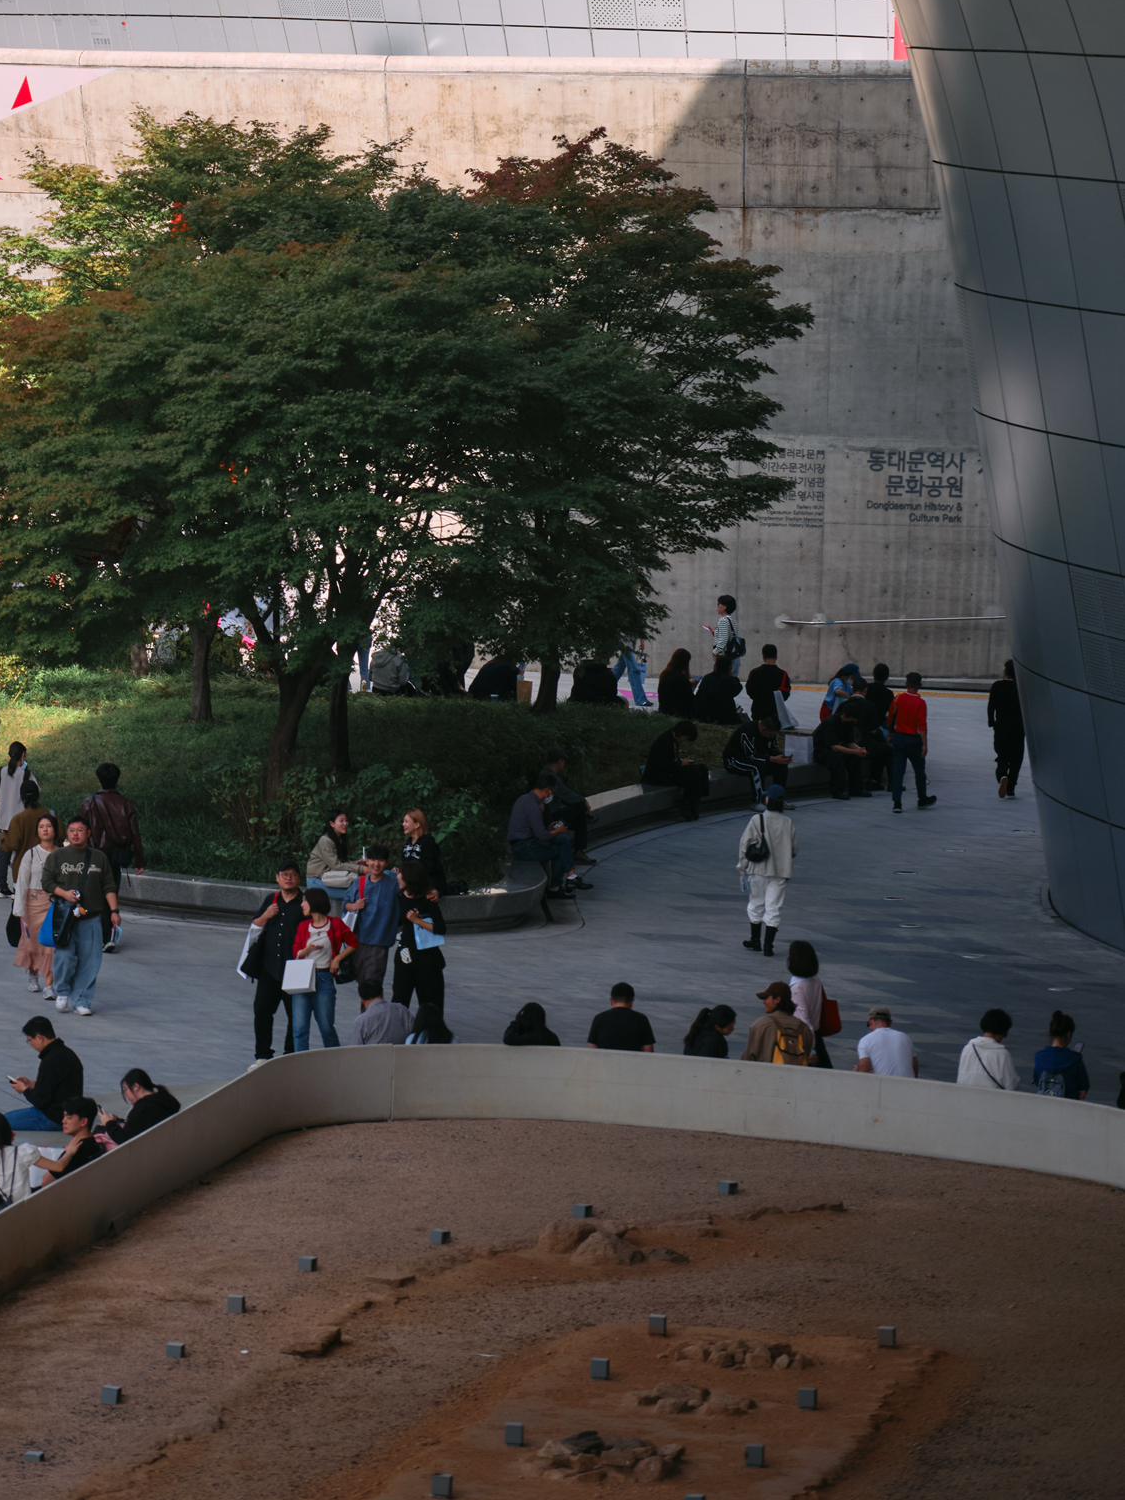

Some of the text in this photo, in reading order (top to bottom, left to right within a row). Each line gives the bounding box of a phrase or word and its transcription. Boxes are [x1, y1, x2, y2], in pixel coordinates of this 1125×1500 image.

[867, 450, 966, 474] 동대문역사
[885, 475, 963, 498] 문화공원
[866, 500, 963, 513] Dongdaemun History &
[909, 513, 962, 523] Culture Park
